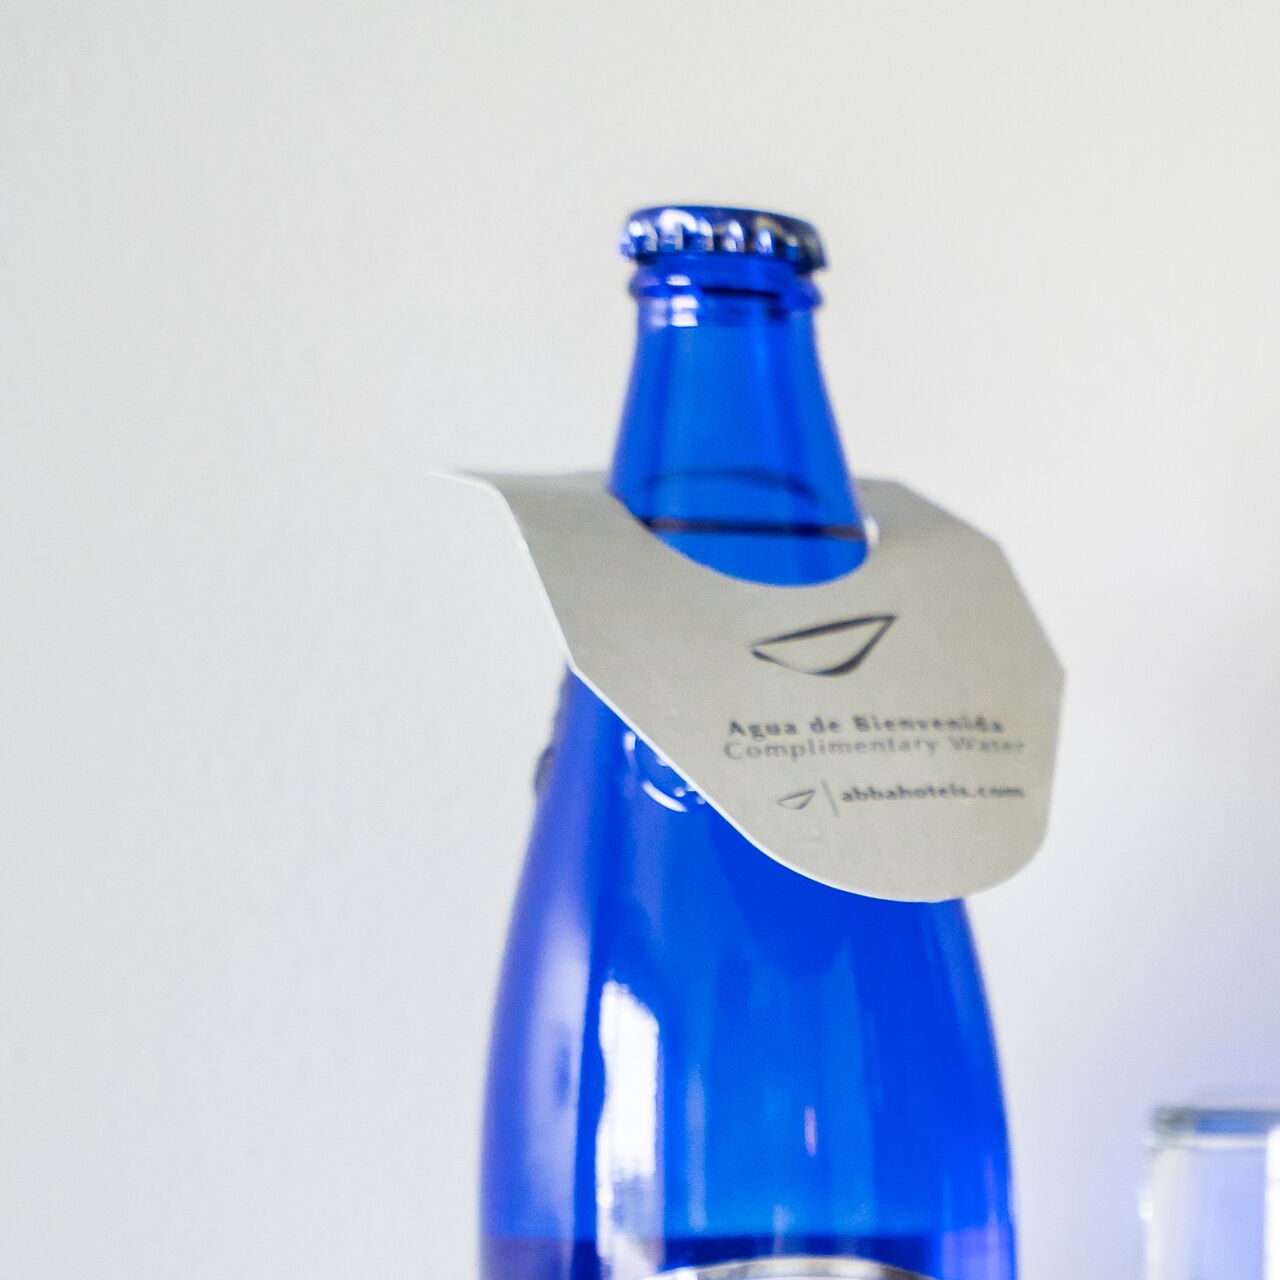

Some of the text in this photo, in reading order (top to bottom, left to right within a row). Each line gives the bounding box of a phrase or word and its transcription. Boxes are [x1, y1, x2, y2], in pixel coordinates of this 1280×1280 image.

[728, 712, 1004, 741] Agua de Bienvenida
[724, 737, 939, 761] Complimentary
[842, 783, 1025, 802] abbahotels.com
